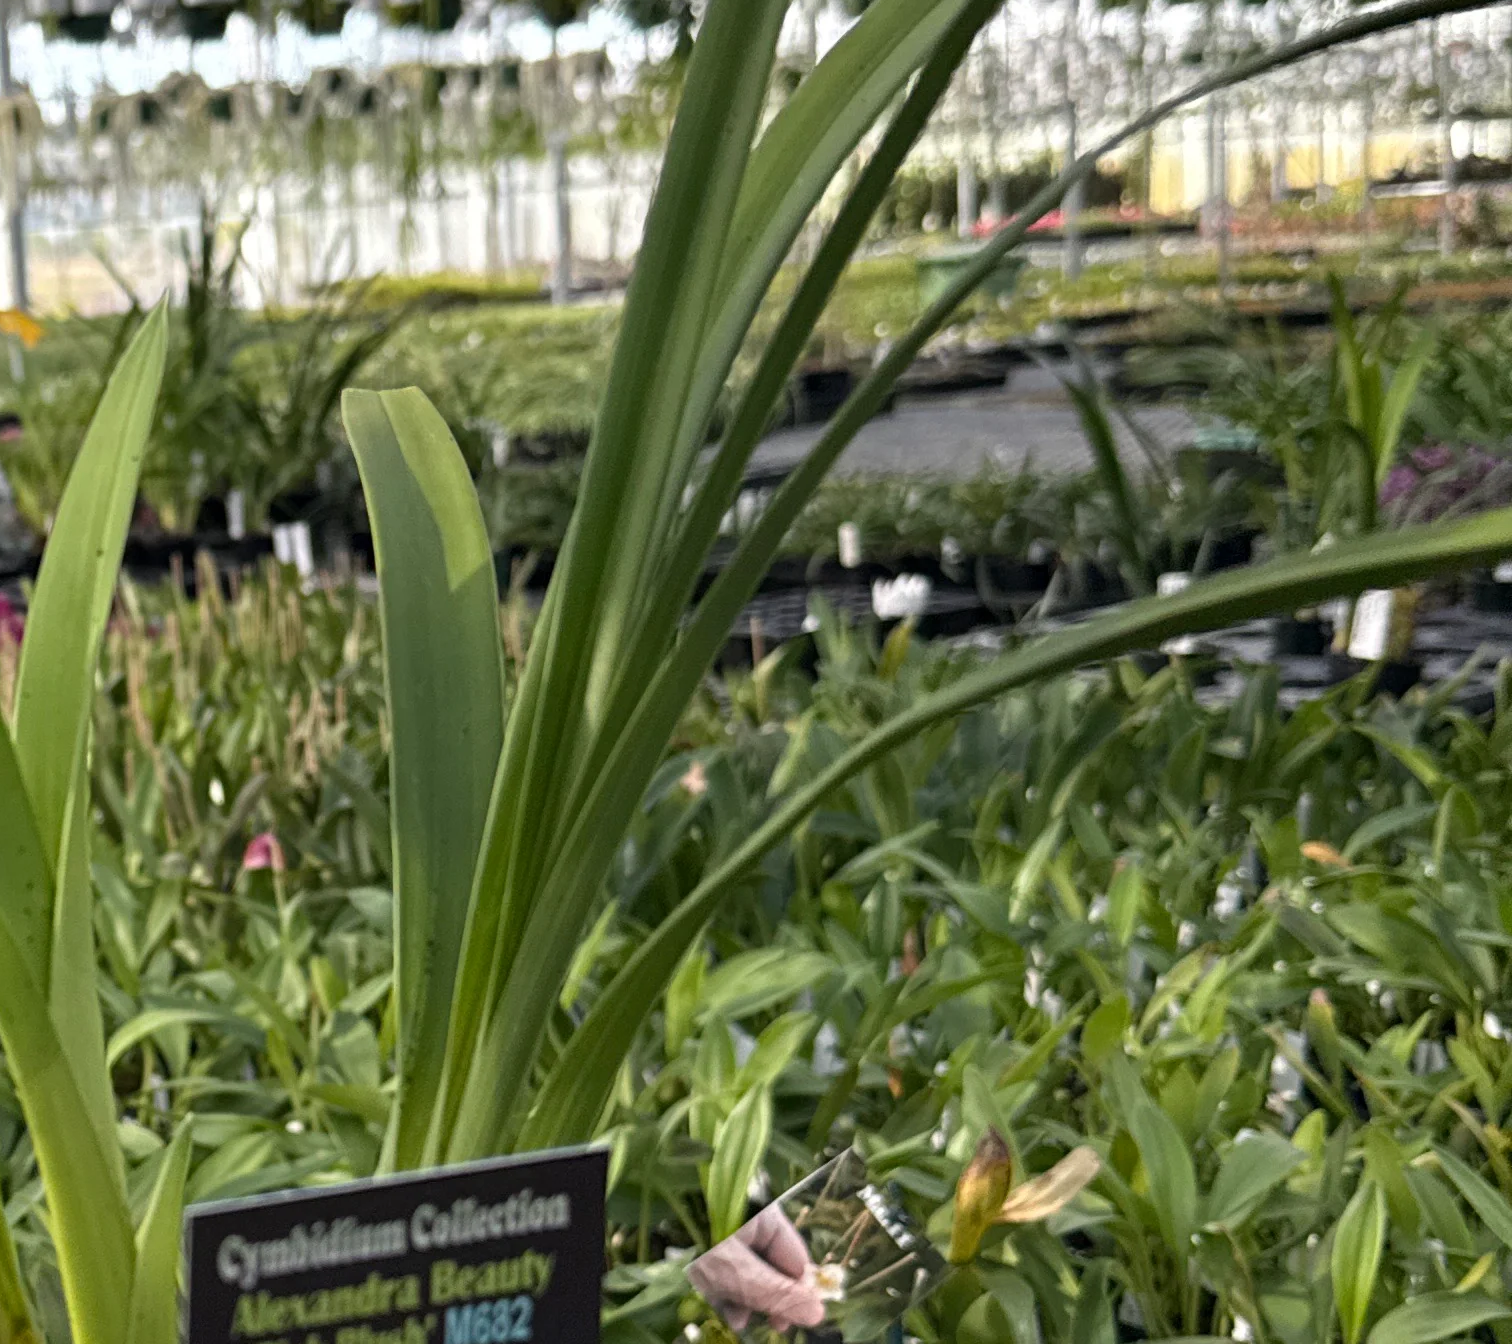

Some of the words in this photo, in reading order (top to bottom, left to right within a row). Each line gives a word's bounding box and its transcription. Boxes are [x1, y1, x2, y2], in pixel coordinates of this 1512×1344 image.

[216, 1215, 408, 1291] Cymbidium
[410, 1187, 571, 1251] Collection
[230, 1270, 422, 1338] Alexandra
[430, 1248, 555, 1305] Beauty
